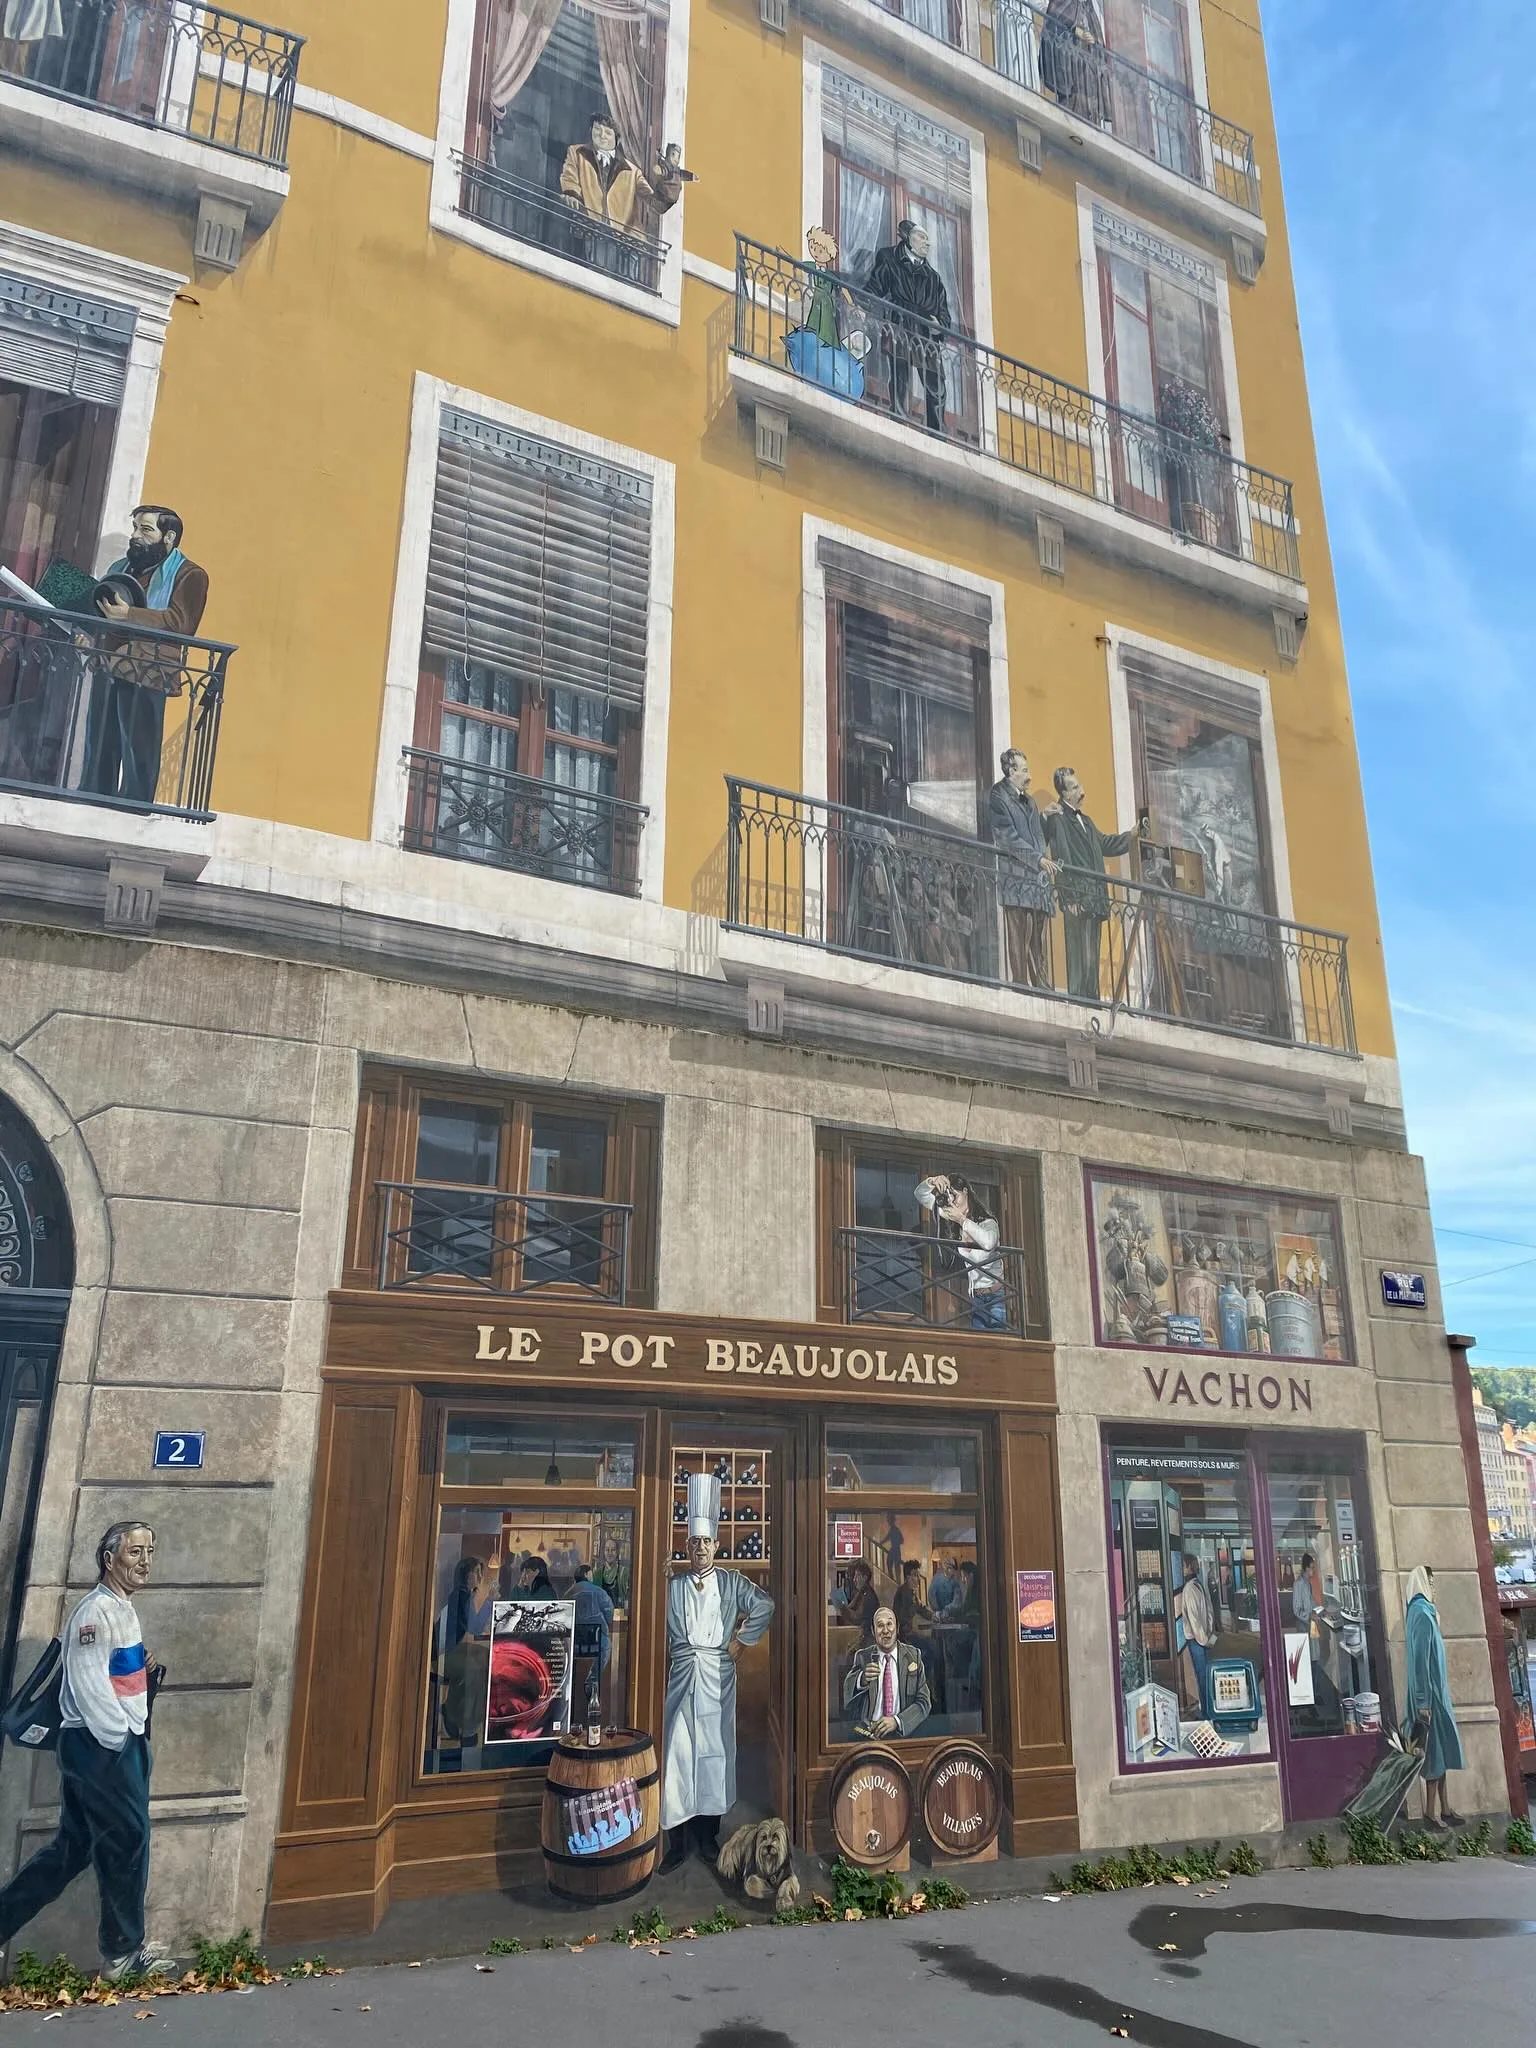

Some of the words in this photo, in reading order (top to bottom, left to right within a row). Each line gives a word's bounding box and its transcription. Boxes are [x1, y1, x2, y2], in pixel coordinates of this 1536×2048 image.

[1397, 1279, 1415, 1289] RUE
[475, 1325, 542, 1363] LE
[579, 1331, 674, 1369] POT
[705, 1338, 959, 1386] BEAUJOLAIS
[1143, 1366, 1312, 1411] VACHON
[168, 1438, 185, 1462] 2
[1198, 1460, 1216, 1470] SOLS
[1220, 1461, 1240, 1470] MURS
[80, 1633, 96, 1644] OL
[936, 1761, 984, 1788] BEAUJOLAIS
[848, 1775, 898, 1801] BEAUJOLAIS
[942, 1812, 983, 1834] VILLAGES
